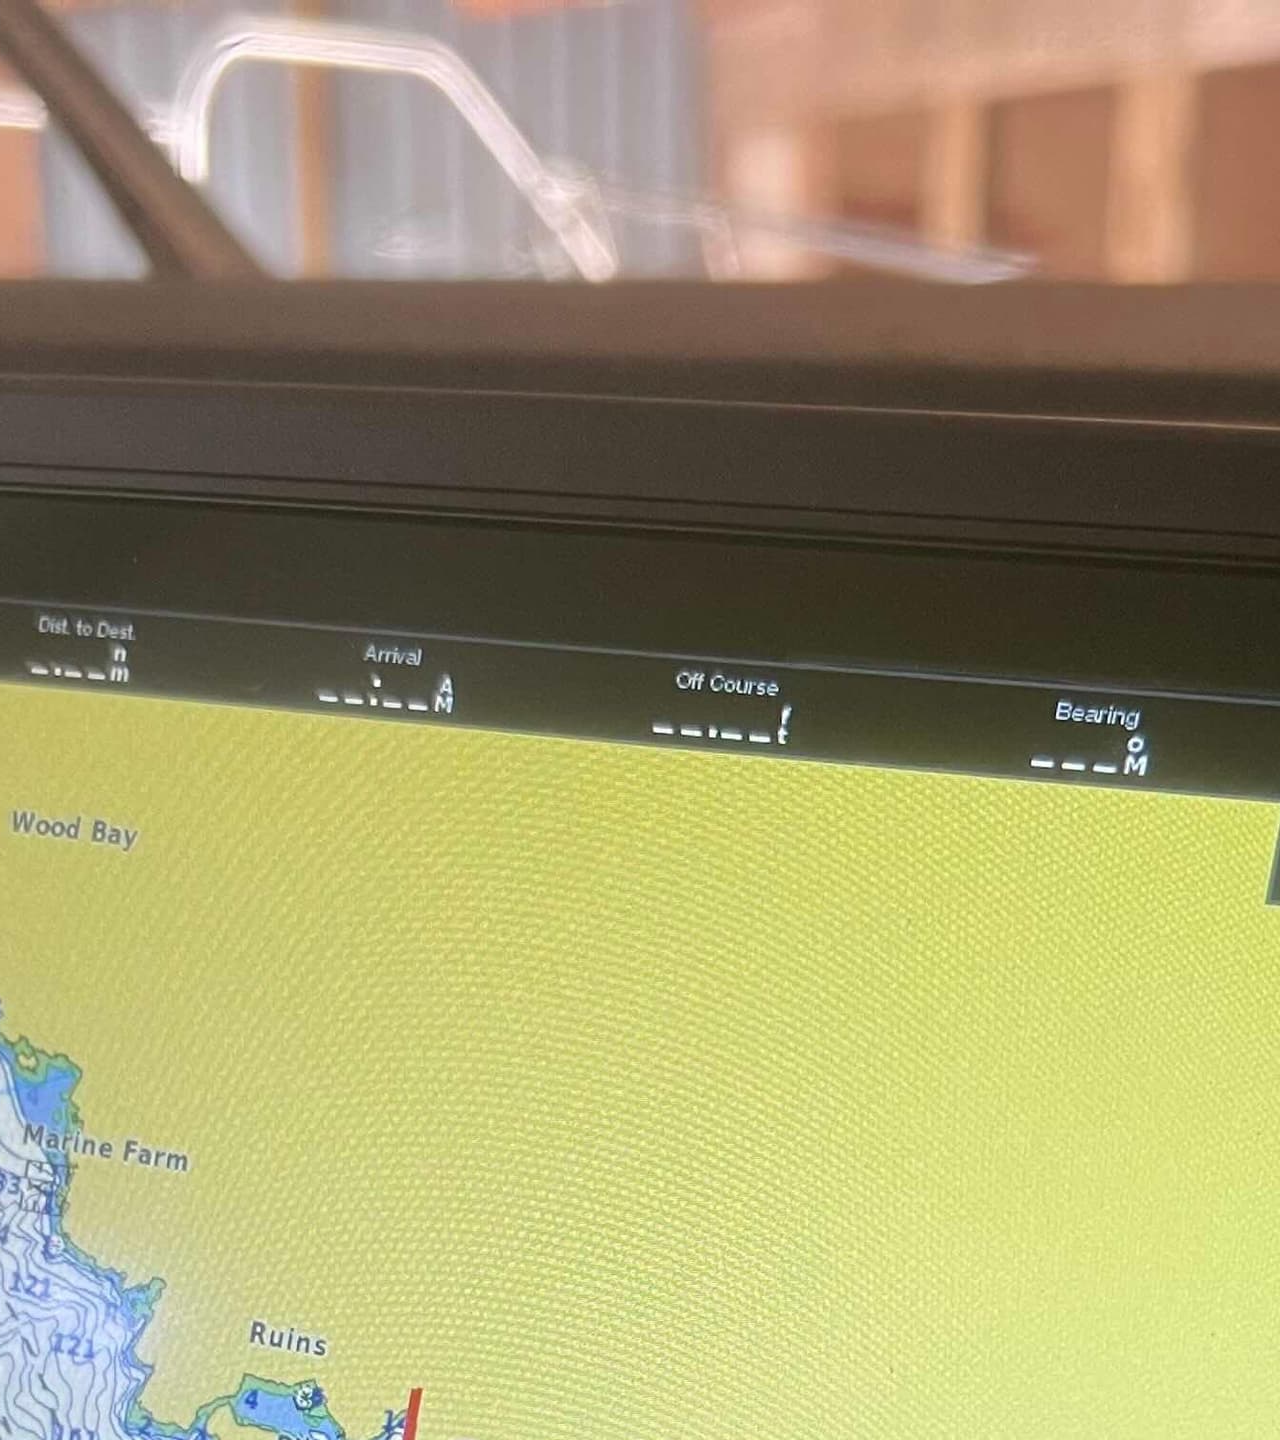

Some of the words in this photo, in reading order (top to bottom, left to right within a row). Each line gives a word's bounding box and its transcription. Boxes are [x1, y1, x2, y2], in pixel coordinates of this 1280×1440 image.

[76, 621, 93, 637] to
[363, 643, 422, 666] Arrival
[676, 672, 704, 692] Off
[710, 675, 780, 697] Course
[1055, 701, 1140, 730] Bearing
[11, 810, 81, 840] Wood
[89, 820, 139, 851] Bay
[23, 1124, 113, 1159] Marine
[123, 1140, 189, 1171] Farm
[250, 1321, 328, 1356] Ruins
